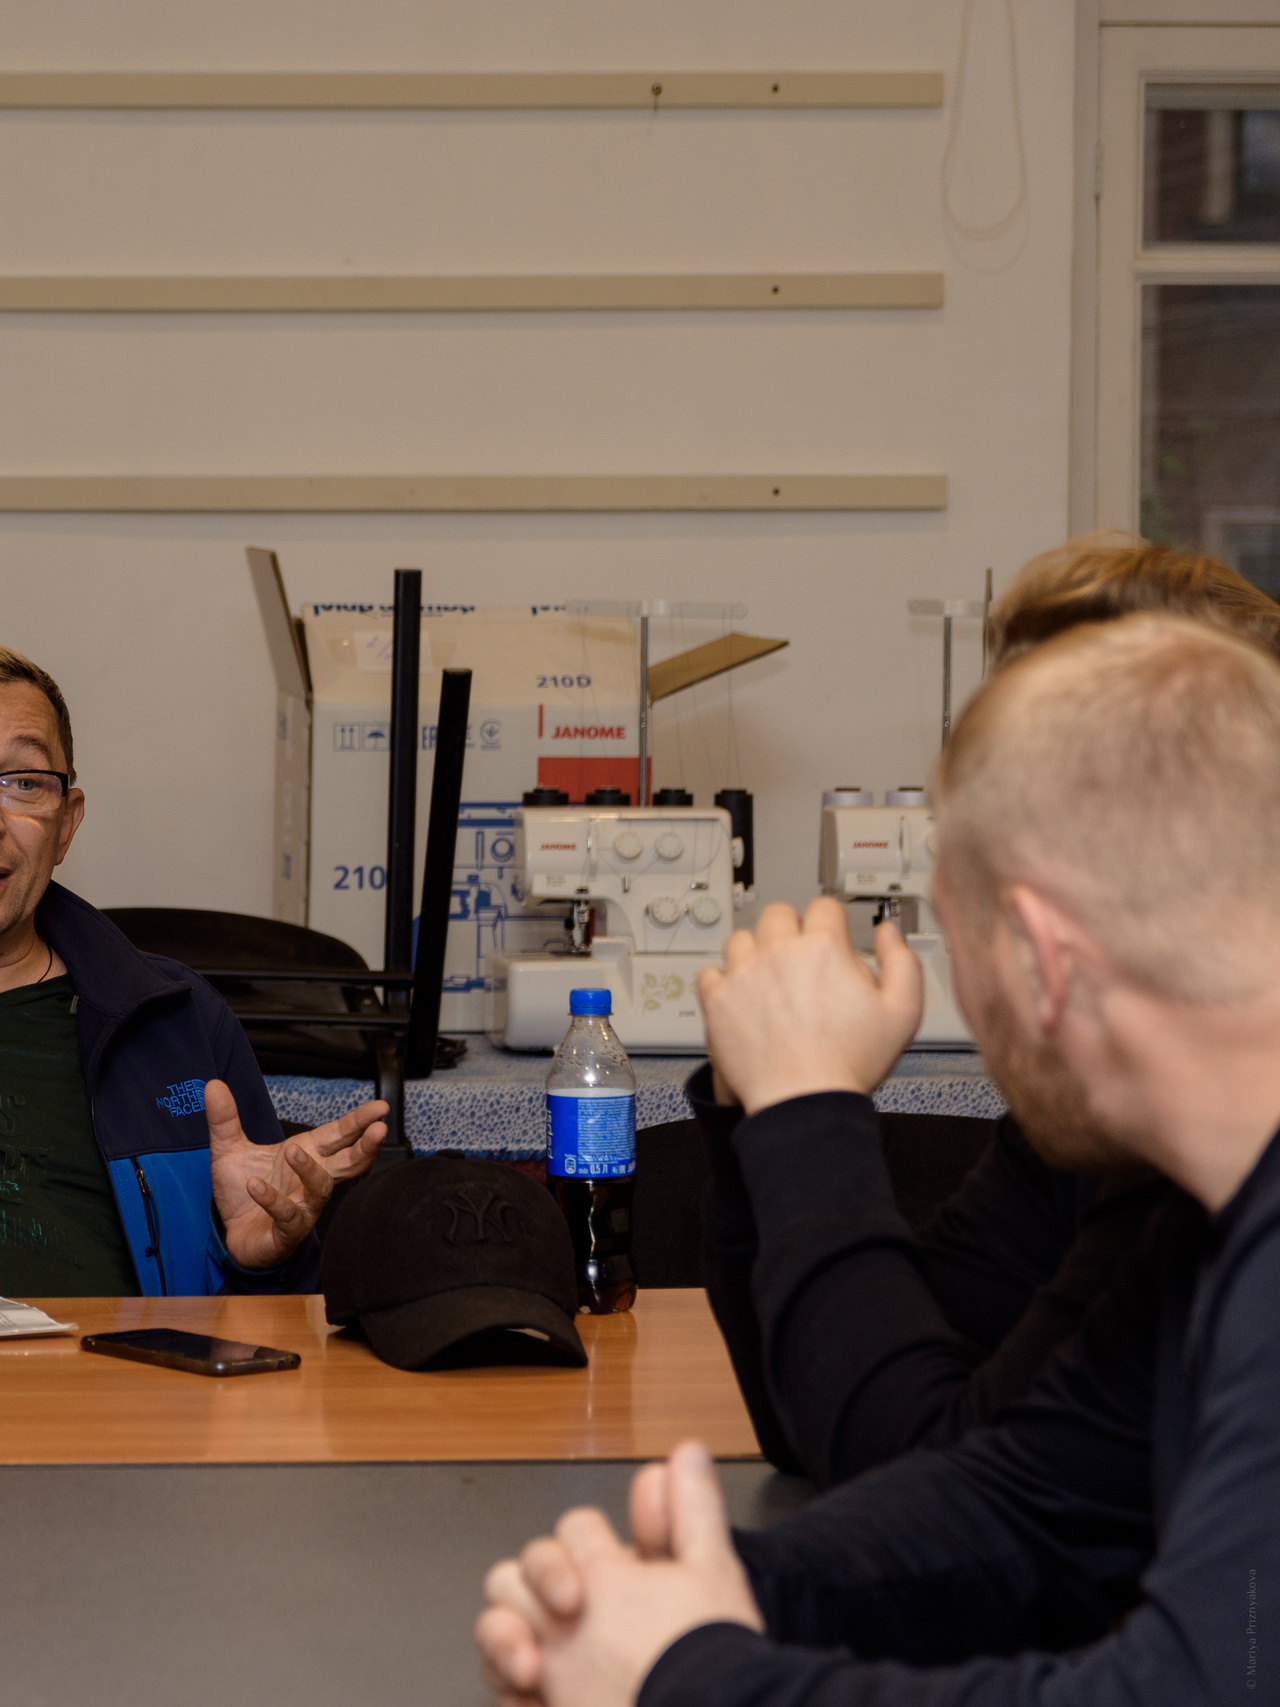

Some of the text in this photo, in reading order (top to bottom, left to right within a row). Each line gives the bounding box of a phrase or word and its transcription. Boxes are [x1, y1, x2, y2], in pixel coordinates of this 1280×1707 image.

[536, 673, 591, 689] 210D
[551, 724, 626, 740] JANOME
[540, 843, 576, 852] JANOME
[166, 1079, 194, 1096] THE
[155, 1090, 198, 1110] NORTH
[168, 1101, 202, 1118] FACE
